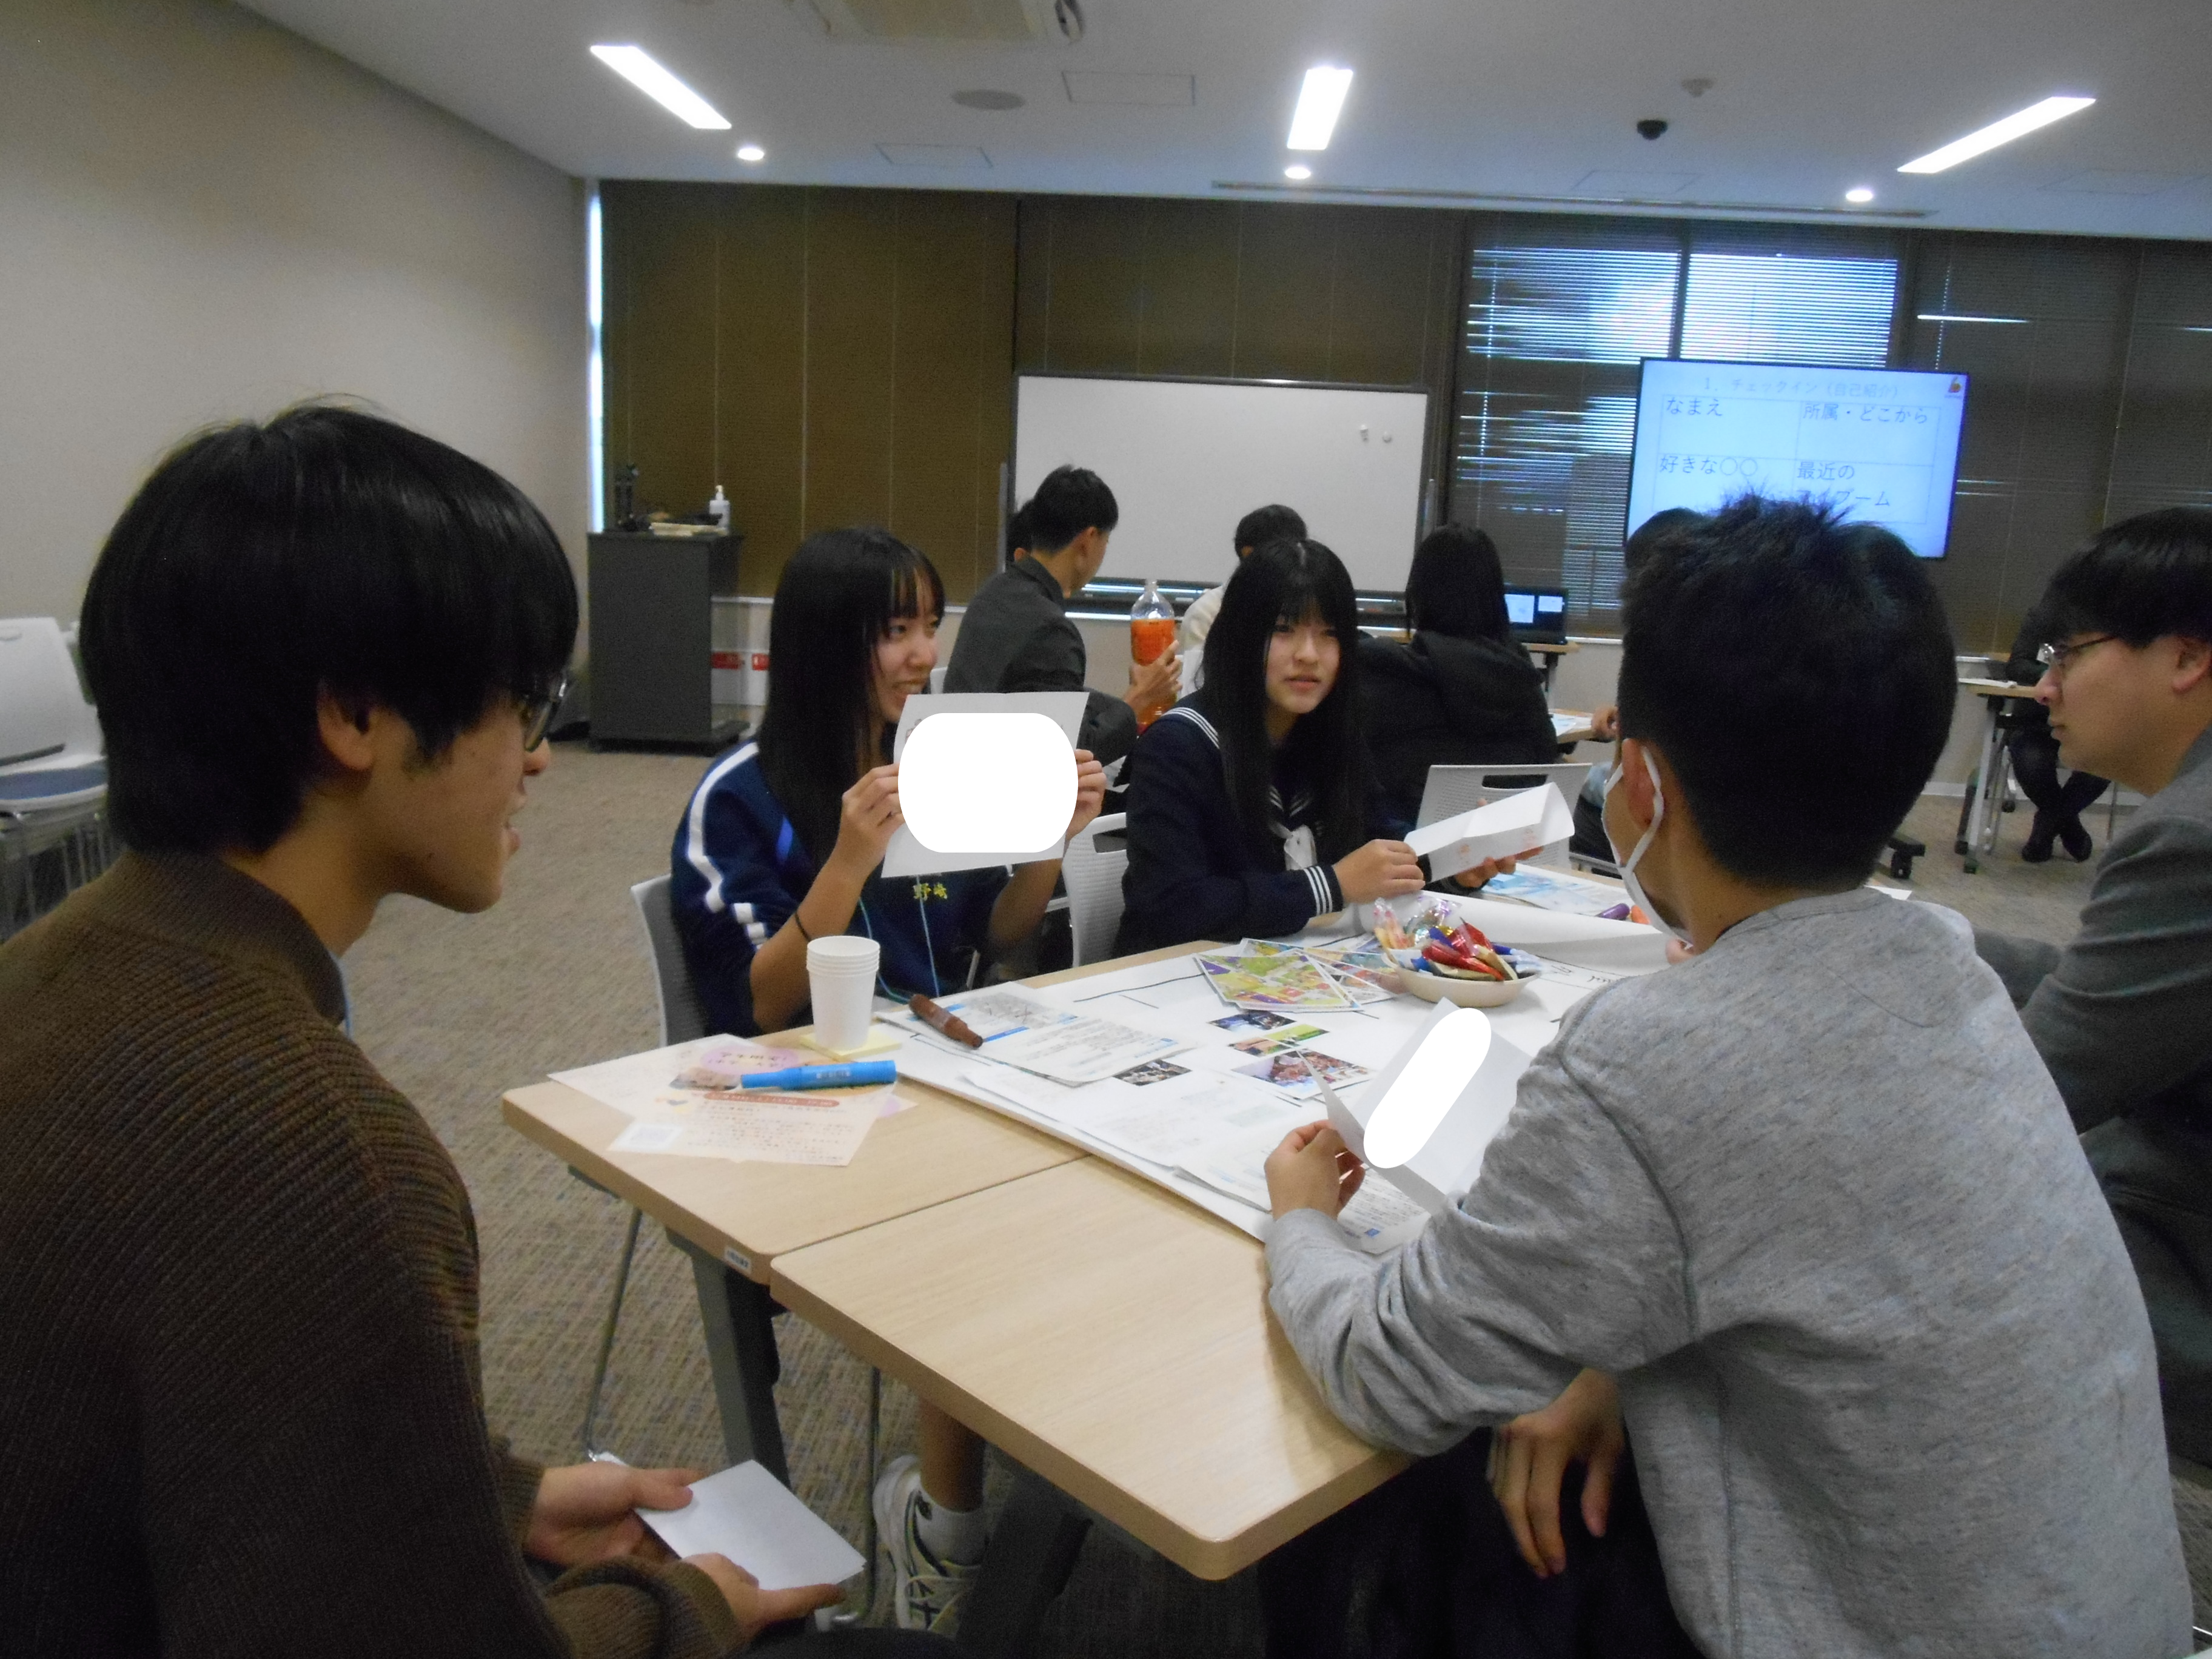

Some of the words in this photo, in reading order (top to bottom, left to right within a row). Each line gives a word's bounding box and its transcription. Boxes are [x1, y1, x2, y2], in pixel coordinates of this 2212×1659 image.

[1666, 397, 1723, 417] なまえ
[1803, 403, 1928, 424] 所属・どこから
[1797, 461, 1854, 480] 最近の
